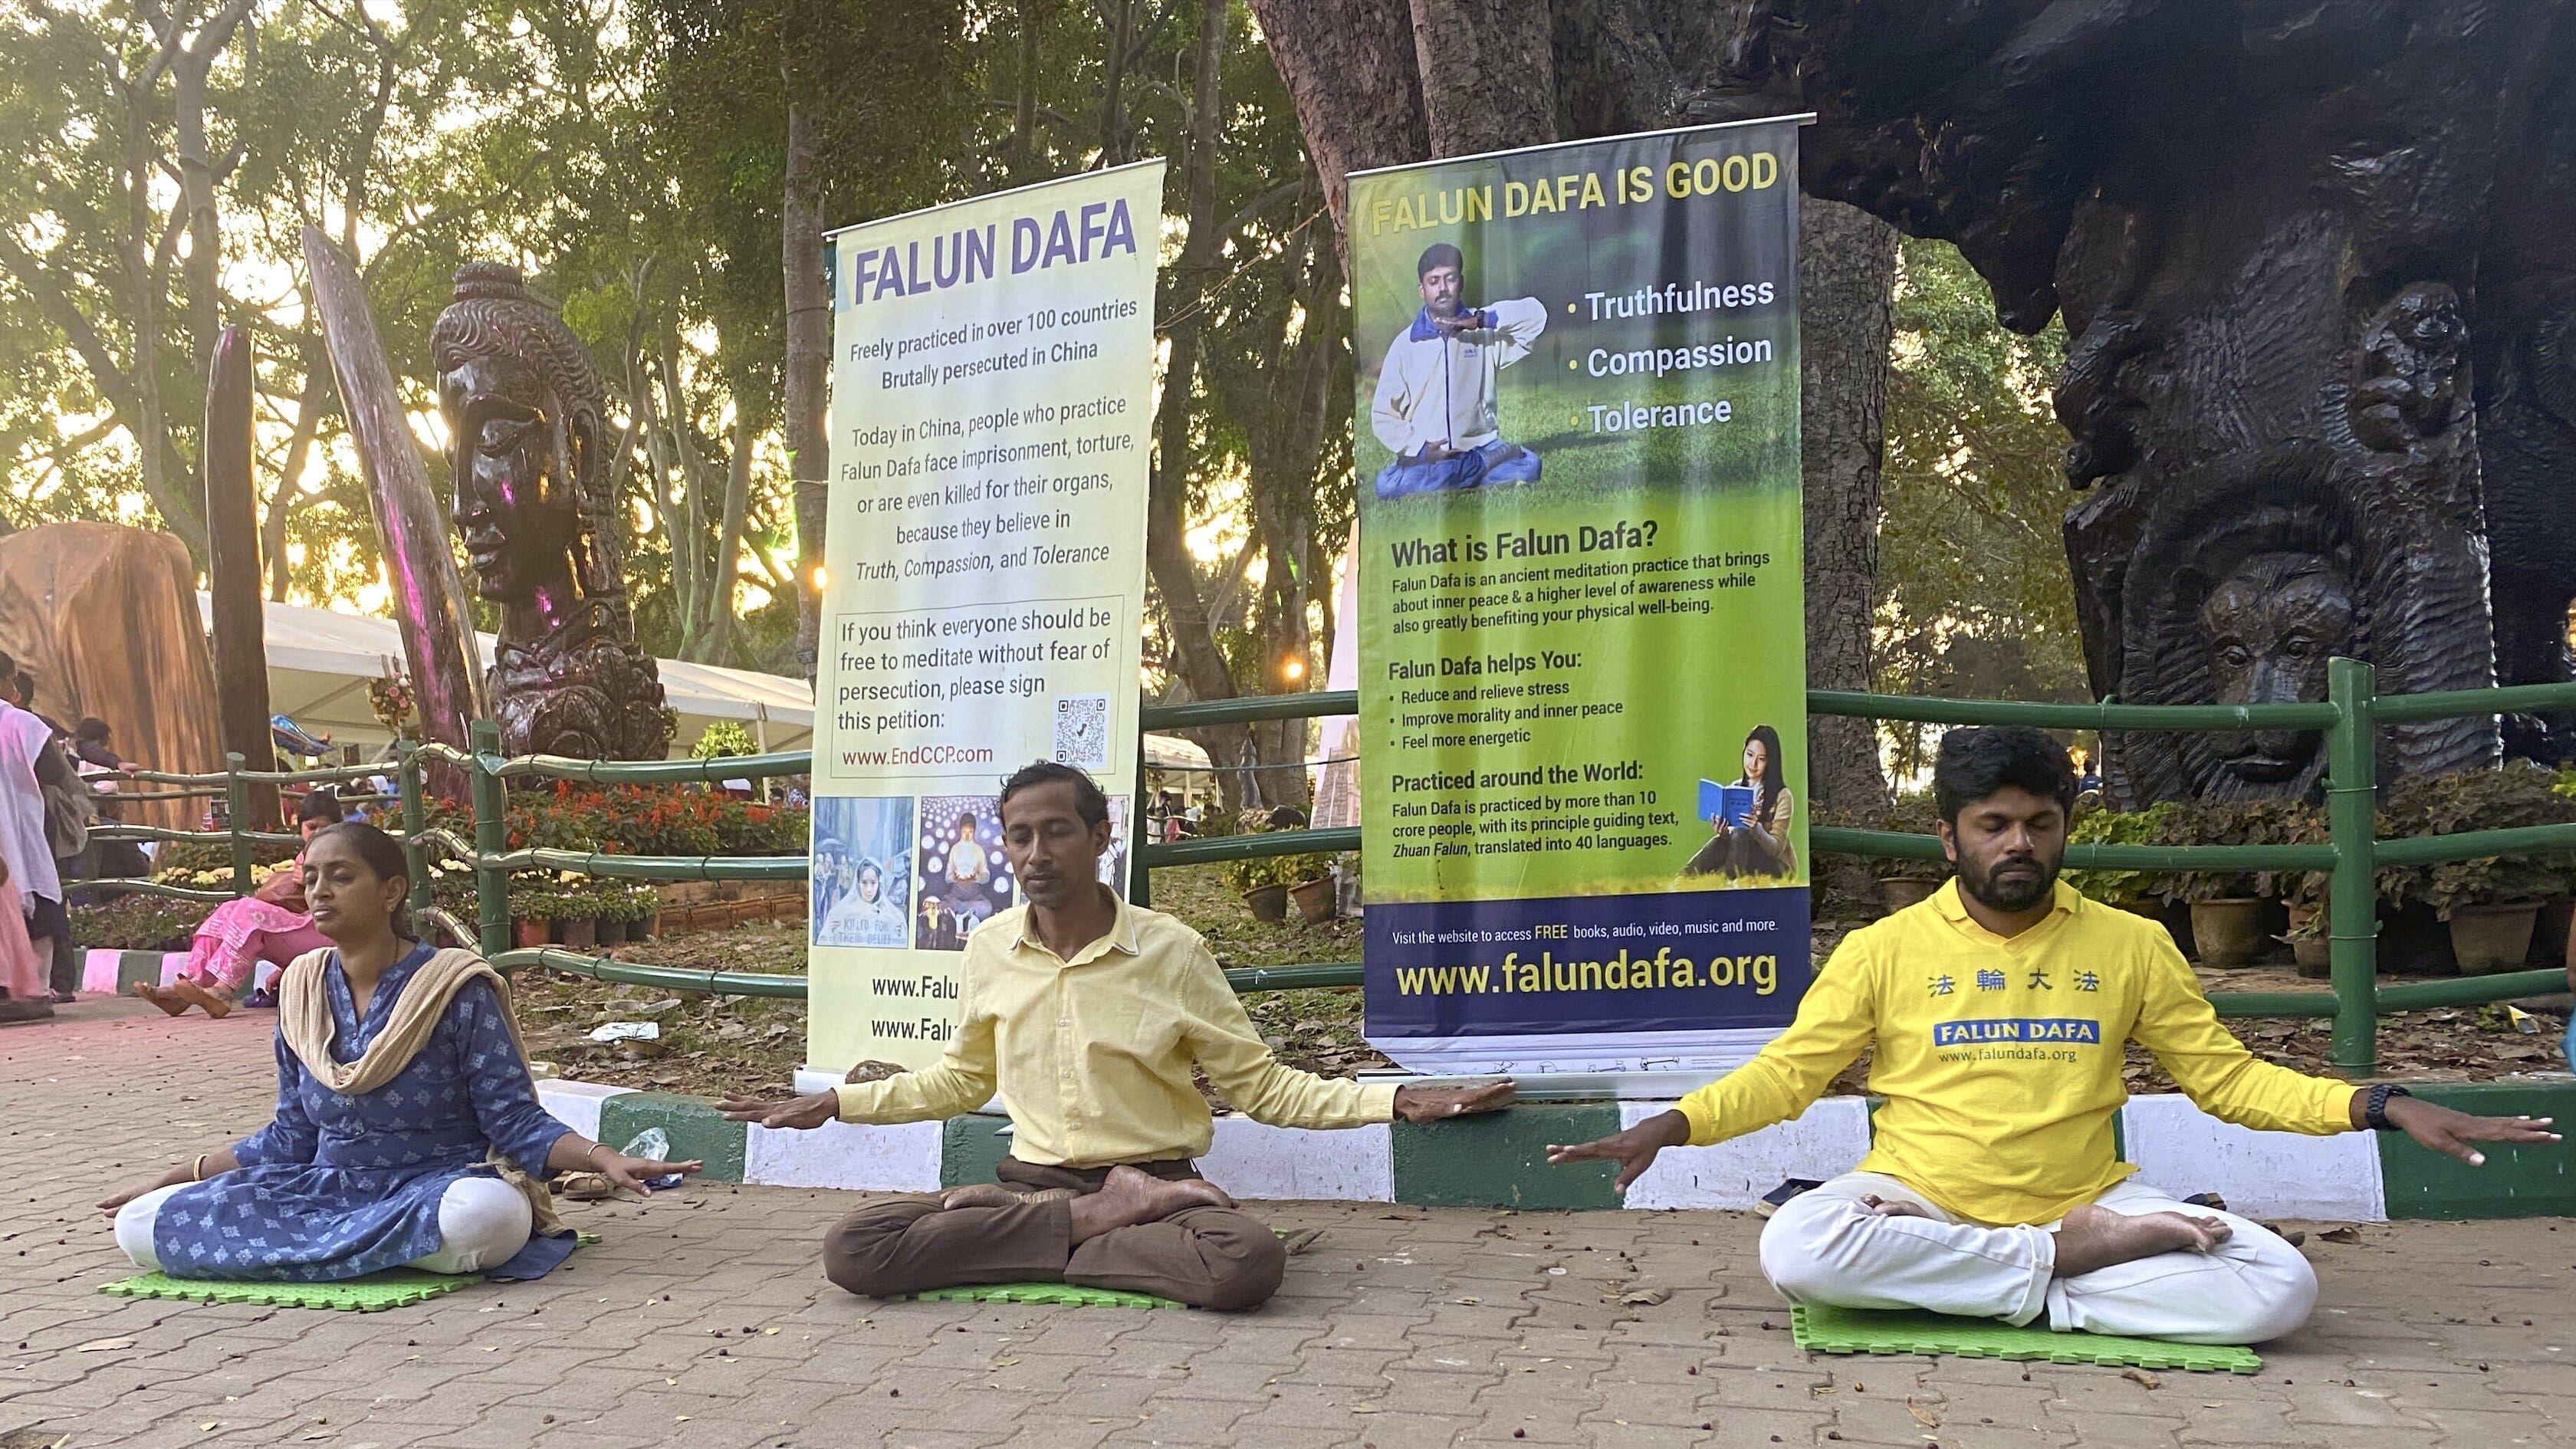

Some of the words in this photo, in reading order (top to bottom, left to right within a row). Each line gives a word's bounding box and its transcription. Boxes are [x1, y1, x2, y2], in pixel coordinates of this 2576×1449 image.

[1371, 186, 1492, 235] FALUN
[1505, 172, 1605, 218] DAFA
[1617, 166, 1653, 204] IS
[1665, 152, 1778, 198] GOOD
[855, 224, 996, 305] FALUN
[1011, 199, 1136, 274] DAFA
[1585, 281, 1774, 320] Truthfulness
[851, 338, 894, 362] Freely
[898, 324, 968, 357] practiced
[972, 323, 984, 340] in
[987, 318, 1022, 337] over
[1027, 310, 1055, 331] 100
[1061, 299, 1137, 326] countries
[882, 366, 938, 389] Brutally
[943, 350, 1028, 382] persecuted
[1033, 347, 1046, 365] in
[1051, 341, 1098, 362] China
[1587, 336, 1771, 377] Compassion
[853, 426, 897, 448] Today
[902, 425, 915, 442] in
[919, 419, 964, 439] China,
[969, 408, 1019, 437] people
[1024, 404, 1054, 423] who
[1060, 396, 1126, 427] practice
[1587, 399, 1731, 432] Tolerance
[841, 462, 881, 481] Falun
[887, 458, 920, 477] Dafa
[925, 455, 958, 471] face
[962, 439, 1071, 469] imprisonment,
[1077, 433, 1134, 455] torture,
[858, 497, 873, 513] or
[879, 496, 902, 511] are
[908, 491, 939, 508] even
[945, 483, 980, 504] killed
[986, 481, 1010, 498] for
[1014, 475, 1047, 496] their
[1053, 472, 1112, 496] organs,
[897, 522, 958, 544] because
[962, 518, 990, 539] they
[997, 514, 1050, 534] believe
[1056, 511, 1070, 528] in
[1391, 538, 1457, 568] What
[1466, 535, 1488, 561] is
[1497, 528, 1570, 559] Falun
[1579, 520, 1658, 553] Dafa?
[857, 561, 899, 581] Truth,
[905, 552, 994, 580] Compassion,
[1001, 547, 1027, 567] and
[1033, 544, 1109, 564] Tolerance
[1392, 577, 1426, 593] Falun
[1431, 573, 1461, 590] Dafa
[1465, 572, 1476, 587] is
[1480, 573, 1496, 586] an
[1500, 567, 1549, 584] ancient
[1554, 560, 1628, 580] meditation
[1632, 557, 1689, 576] practice
[1694, 553, 1720, 570] that
[1726, 550, 1770, 568] brings
[1392, 596, 1428, 614] about
[1432, 593, 1465, 610] inner
[1468, 592, 1508, 610] peace
[1513, 590, 1522, 603] &
[1526, 591, 1534, 603] a
[1537, 585, 1581, 604] higher
[1585, 582, 1616, 599] level
[1621, 580, 1635, 596] of
[1638, 575, 1714, 593] awareness
[1718, 573, 1756, 588] while
[843, 623, 854, 641] If
[859, 626, 891, 646] you
[897, 618, 936, 639] think
[943, 616, 1017, 639] everyone
[1022, 609, 1083, 630] should
[1090, 607, 1111, 626] be
[1394, 619, 1418, 635] also
[1423, 614, 1467, 633] greatly
[1471, 608, 1539, 629] benefiting
[1543, 607, 1572, 626] your
[1576, 602, 1635, 622] physical
[1638, 596, 1714, 616] well-being.
[841, 652, 875, 671] free
[881, 653, 898, 669] to
[903, 647, 972, 669] meditate
[978, 642, 1043, 664] without
[1050, 641, 1086, 660] fear
[1092, 639, 1112, 659] of
[1389, 660, 1435, 679] Falun
[1441, 656, 1482, 676] Dafa
[1487, 653, 1536, 676] helps
[1541, 651, 1582, 669] You:
[840, 682, 945, 705] persecution,
[950, 675, 1004, 702] please
[1010, 676, 1045, 697] sign
[1401, 689, 1449, 705] Reduce
[1453, 687, 1477, 702] and
[1480, 683, 1523, 699] relieve
[1528, 682, 1569, 696] stress
[838, 712, 871, 731] this
[877, 711, 945, 734] petition:
[1402, 710, 1454, 728] Improve
[1457, 705, 1510, 724] morality
[1514, 705, 1539, 719] and
[1544, 702, 1578, 718] inner
[1582, 701, 1623, 718] peace
[843, 744, 993, 765] www.EndCCP.com
[1402, 734, 1428, 749] Feel
[1432, 731, 1465, 748] more
[1469, 728, 1530, 747] energetic
[1392, 770, 1475, 792] Practiced
[1480, 765, 1543, 788] around
[1548, 765, 1578, 784] the
[1583, 760, 1643, 782] World:
[1392, 801, 1427, 817] Falun
[1431, 800, 1461, 815] Dafa
[1464, 800, 1476, 814] is
[1480, 793, 1541, 816] practiced
[1545, 794, 1561, 812] by
[1565, 795, 1600, 808] more
[1604, 792, 1635, 807] than
[1639, 790, 1656, 805] 10
[1392, 823, 1425, 837] crore
[1428, 820, 1476, 840] people,
[1480, 818, 1506, 834] with
[1510, 816, 1527, 832] its
[1531, 813, 1589, 834] principle
[1593, 809, 1645, 830] guiding
[1648, 810, 1679, 826] text,
[1393, 843, 1430, 858] Zhuan
[1434, 842, 1470, 857] Falun,
[1475, 839, 1542, 856] translated
[1545, 837, 1572, 850] into
[1576, 836, 1592, 850] 40
[1596, 834, 1672, 852] languages.
[1392, 931, 1415, 945] Visit
[1418, 930, 1435, 945] the
[1438, 929, 1478, 944] website
[1481, 929, 1492, 941] to
[1495, 928, 1532, 942] access
[1536, 924, 1568, 940] FREE
[1573, 922, 1609, 940] books,
[1612, 922, 1645, 938] audio,
[1649, 921, 1681, 937] video,
[1685, 920, 1719, 934] music
[1722, 919, 1743, 934] and
[1746, 918, 1778, 933] more.
[872, 975, 958, 1000] www.Falu
[1396, 946, 1777, 996] www.falundafa.org
[1941, 1023, 2020, 1041] FALUN
[2029, 1024, 2094, 1040] DAFA
[1939, 1048, 2076, 1063] www.falundafa.org
